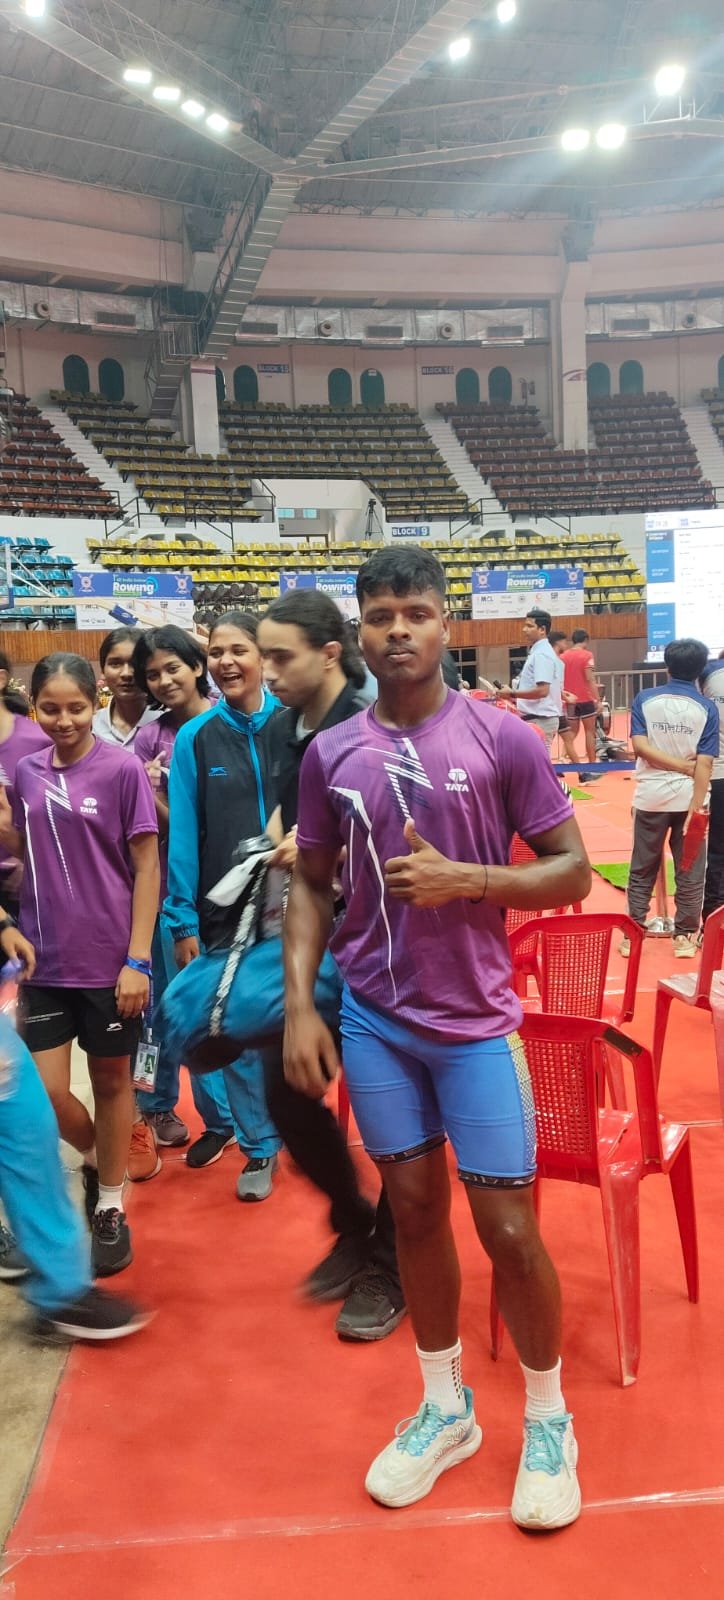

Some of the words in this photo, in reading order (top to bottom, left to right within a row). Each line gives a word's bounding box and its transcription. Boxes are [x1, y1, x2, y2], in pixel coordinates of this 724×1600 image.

[392, 527, 416, 536] BLOCK
[421, 526, 428, 536] 9
[506, 578, 545, 588] Rowing
[113, 582, 154, 595] Rowing
[315, 583, 354, 594] Rowing
[444, 783, 469, 793] TATA
[79, 806, 98, 815] TATA
